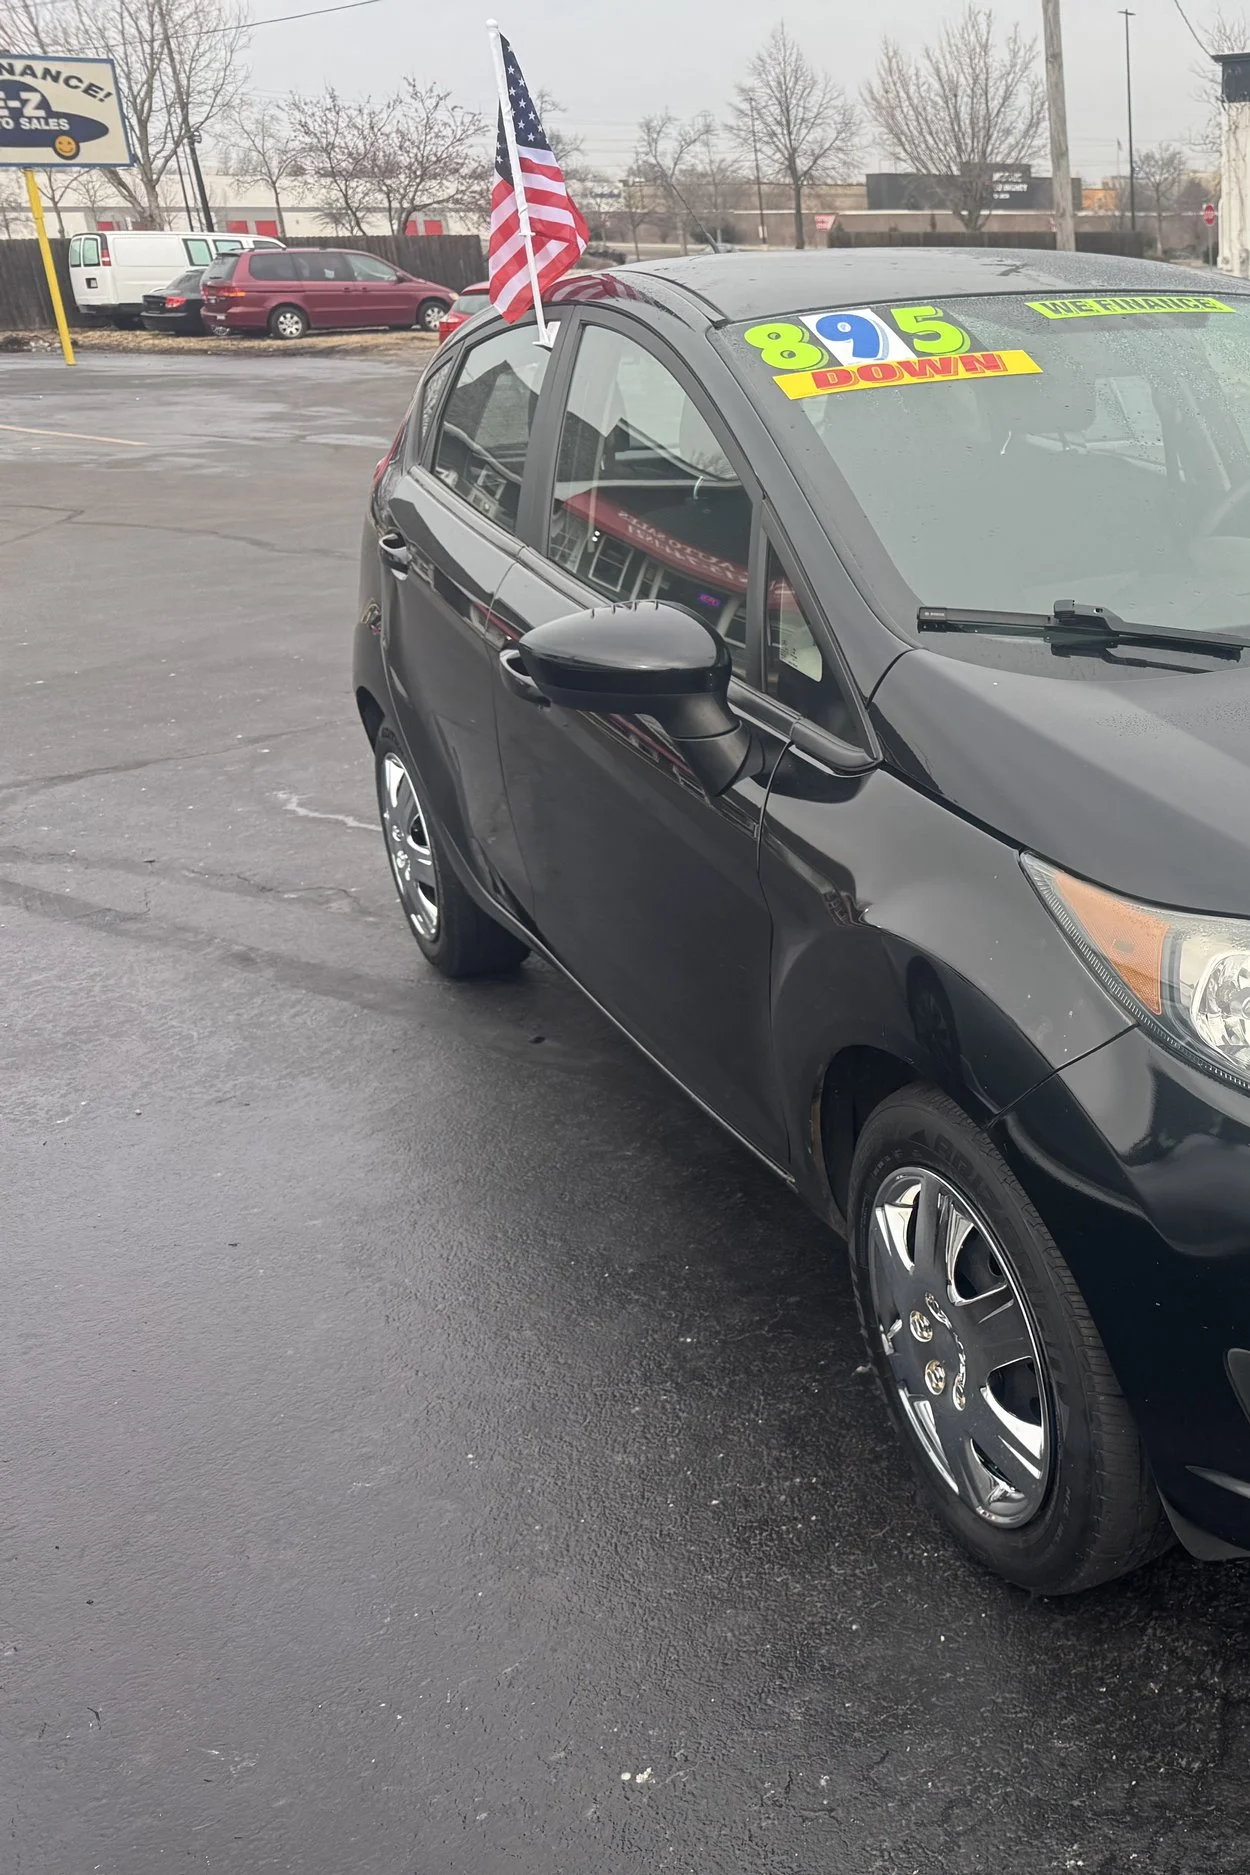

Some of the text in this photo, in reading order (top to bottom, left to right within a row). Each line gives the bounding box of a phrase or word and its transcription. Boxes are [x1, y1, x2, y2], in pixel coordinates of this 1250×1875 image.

[20, 118, 70, 130] SALES
[1039, 297, 1223, 316] WE FINANCE
[744, 306, 971, 370] 895
[811, 353, 1009, 390] DOWN
